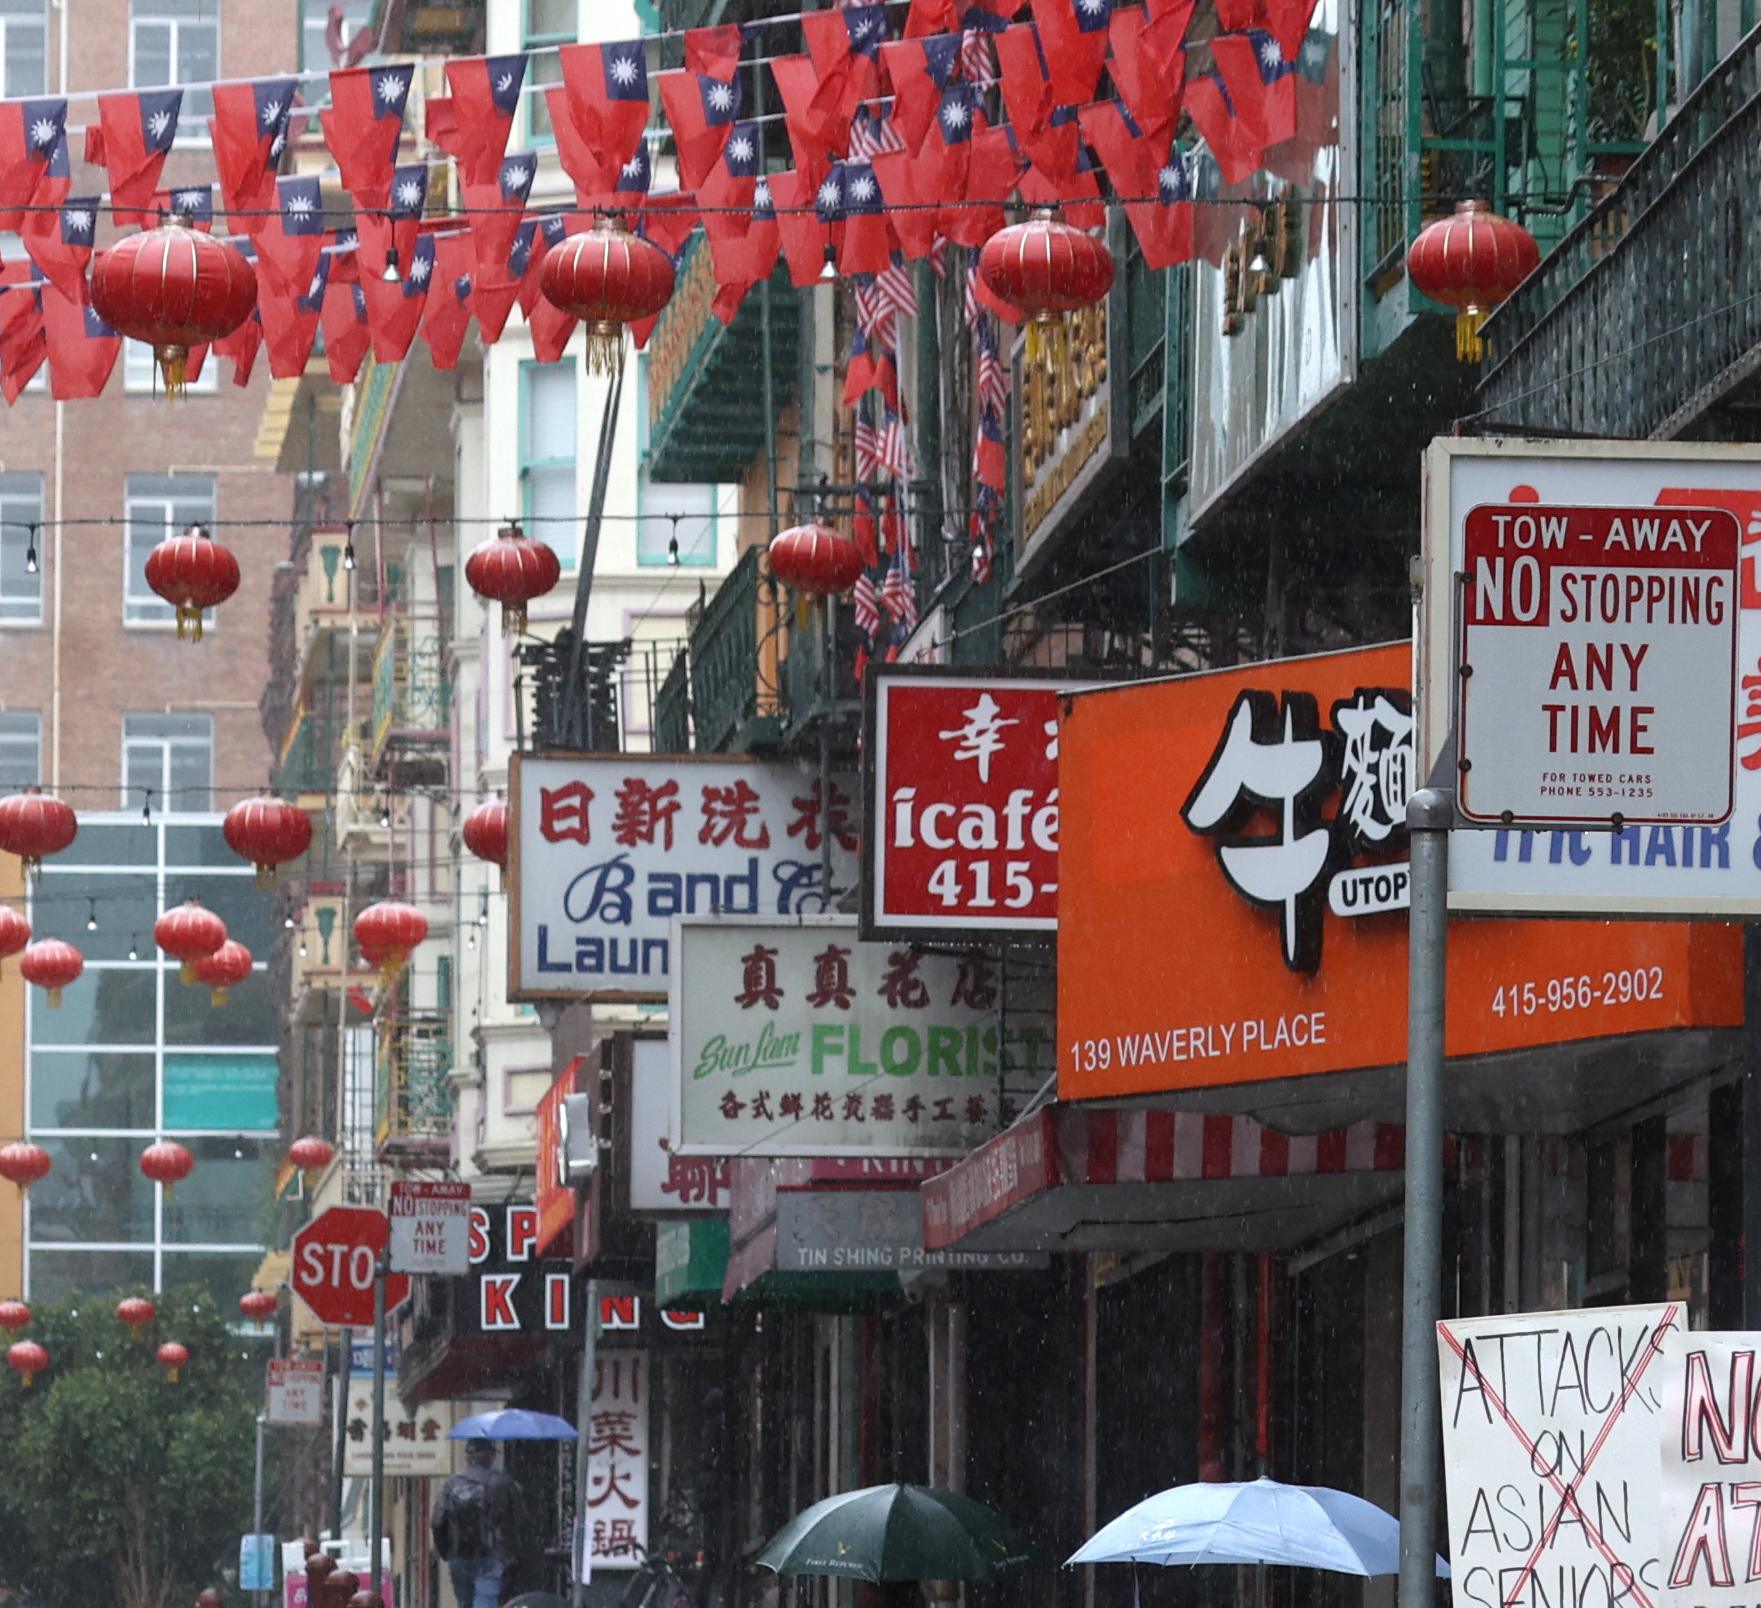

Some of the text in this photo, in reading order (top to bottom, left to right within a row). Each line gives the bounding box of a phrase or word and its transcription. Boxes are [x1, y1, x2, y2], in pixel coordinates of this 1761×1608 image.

[1491, 515, 1712, 552] TOW AWAY
[1475, 555, 1725, 626] NO STOPPING
[1549, 642, 1650, 692] ANY
[1542, 704, 1655, 755] TIME
[1540, 786, 1654, 799] PHONE 553-1235
[1542, 772, 1652, 786] FOR TOWED CARS
[647, 857, 759, 917] and
[1491, 966, 1664, 1019] 415-956-2902
[693, 1034, 751, 1080] Sun
[811, 1023, 1047, 1078] FLORIST
[1071, 1011, 1327, 1072] 139 WAVERLY PLACE
[392, 1197, 468, 1217] NO STOPPING
[414, 1221, 445, 1237] ANY
[301, 1241, 386, 1291] STO
[413, 1239, 447, 1256] TIME
[797, 1247, 826, 1266] TIN
[833, 1247, 893, 1266] SHING
[1531, 1430, 1589, 1478] ON
[1463, 1484, 1631, 1558] ASIAN
